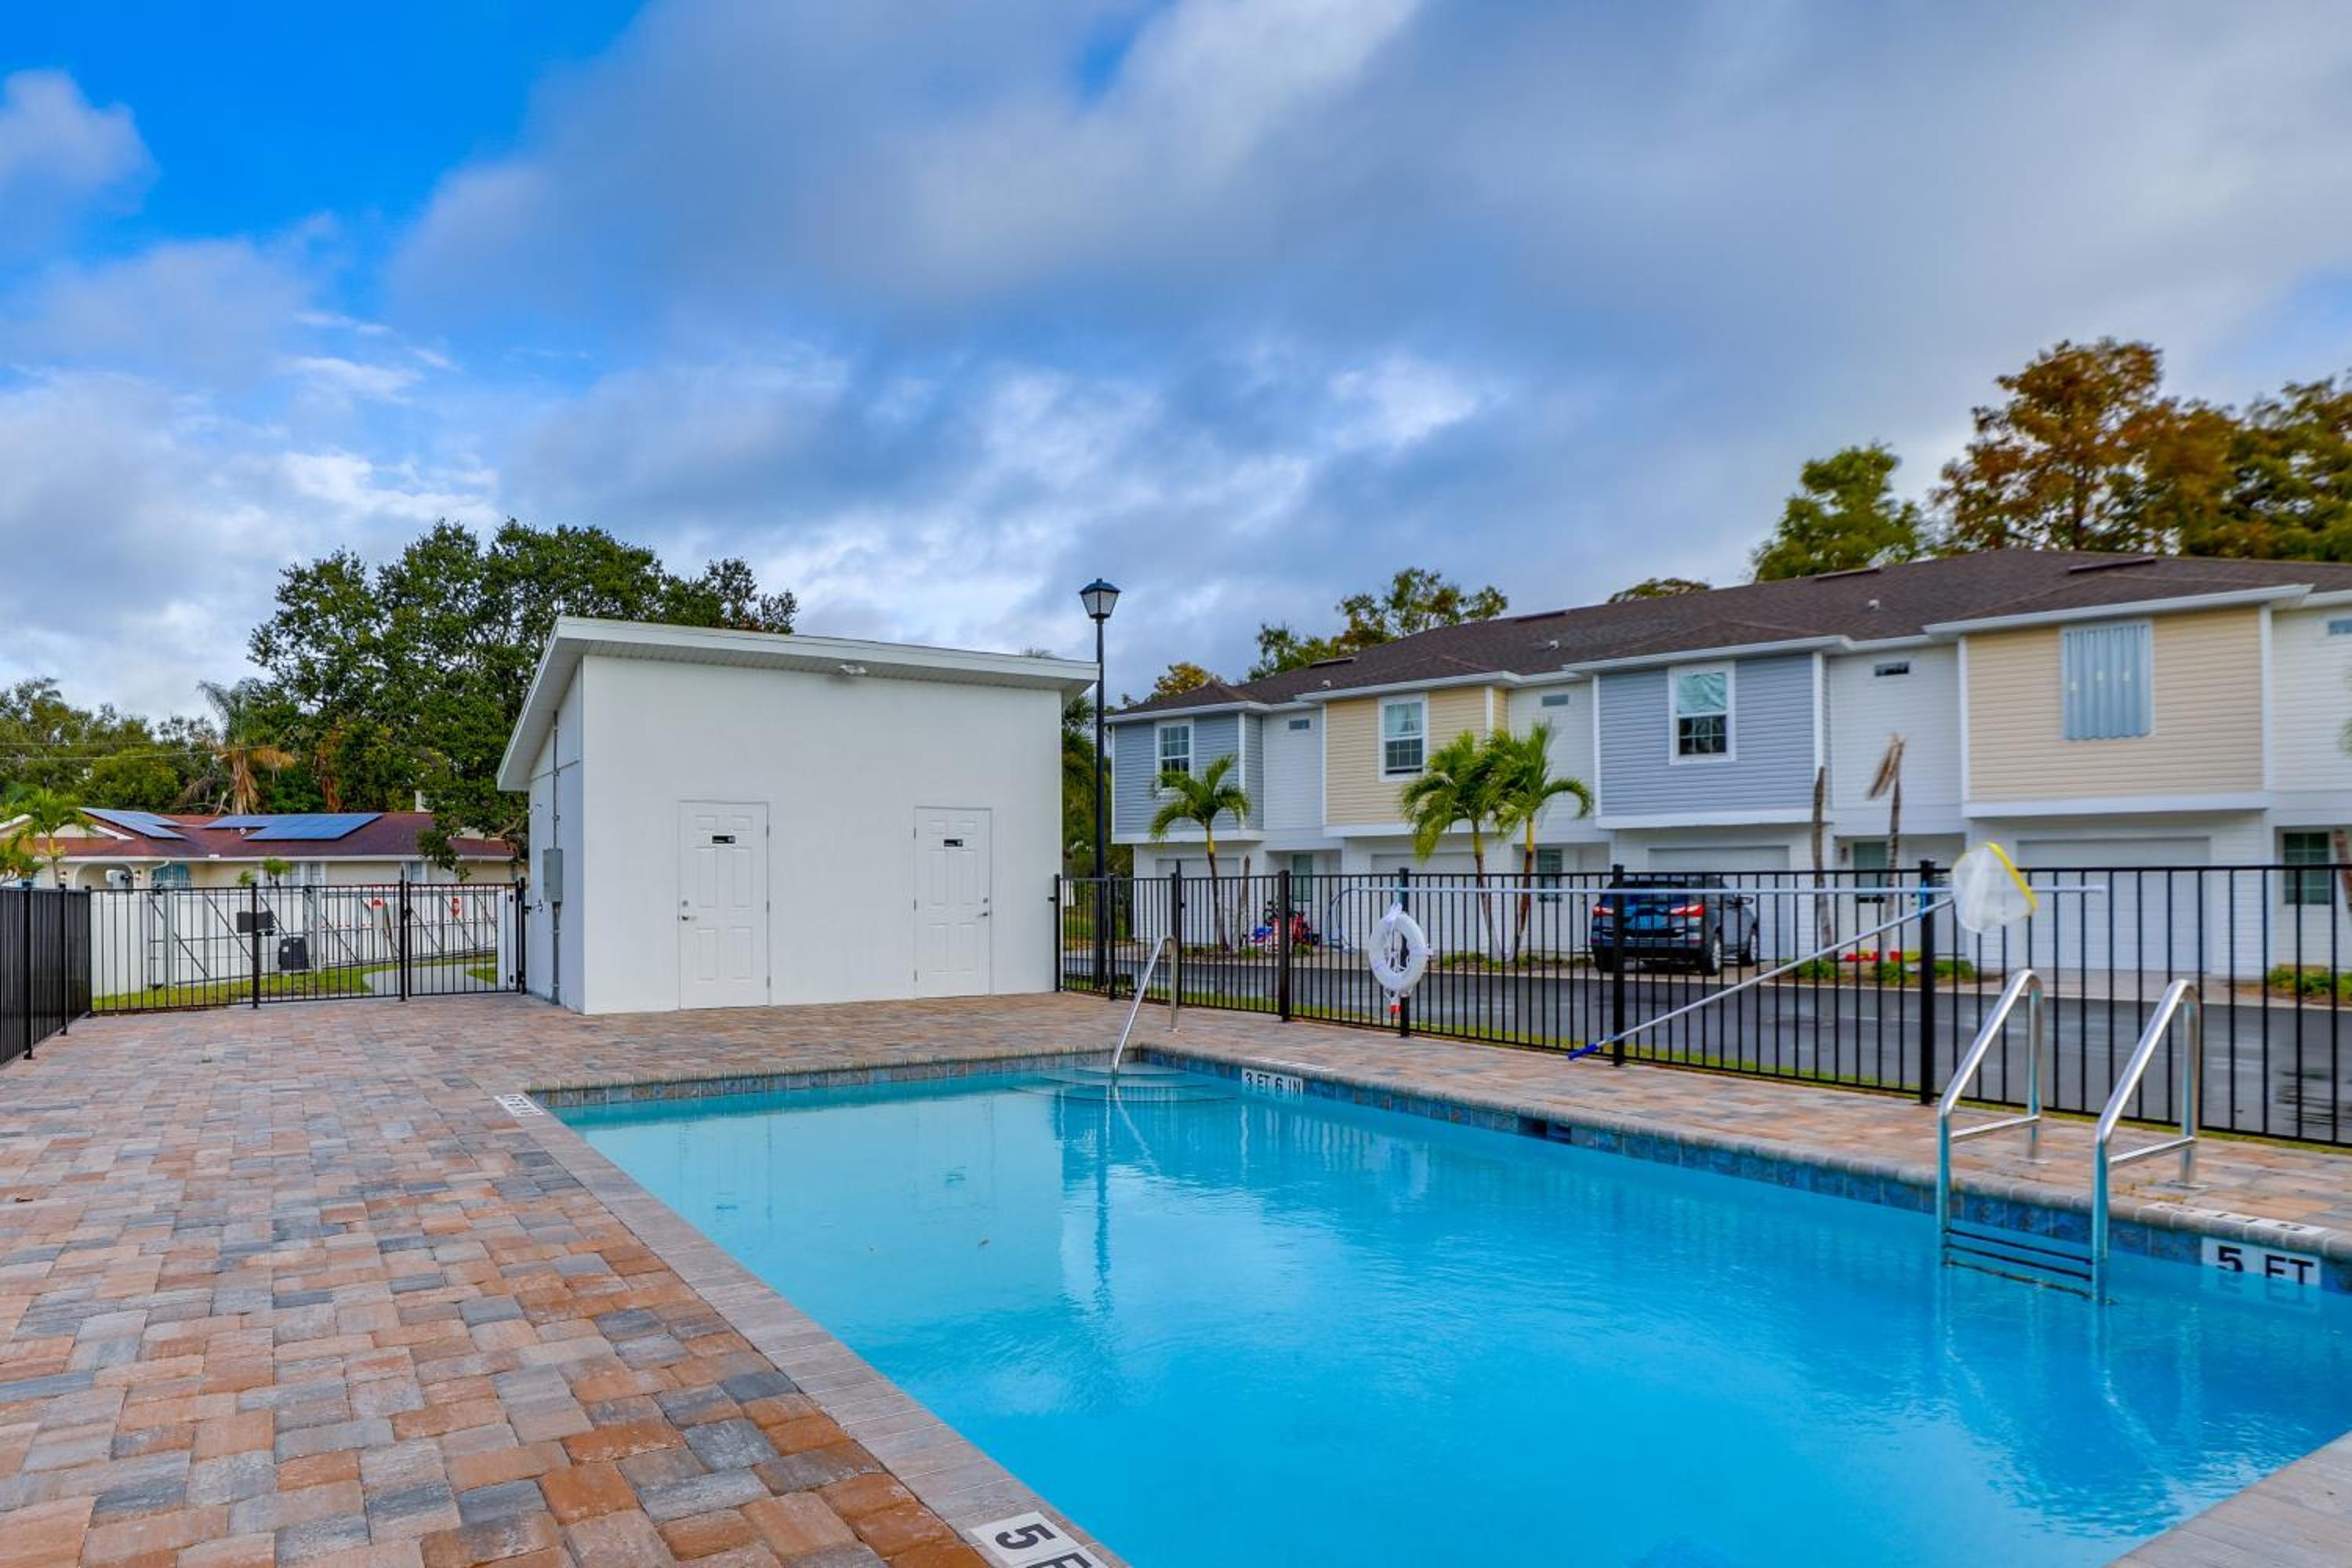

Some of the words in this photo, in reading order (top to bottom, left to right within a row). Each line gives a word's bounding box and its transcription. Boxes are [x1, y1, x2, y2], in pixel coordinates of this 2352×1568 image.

[2217, 1245, 2244, 1272] 5
[2265, 1254, 2314, 1285] FT
[995, 1523, 1057, 1550] 5
